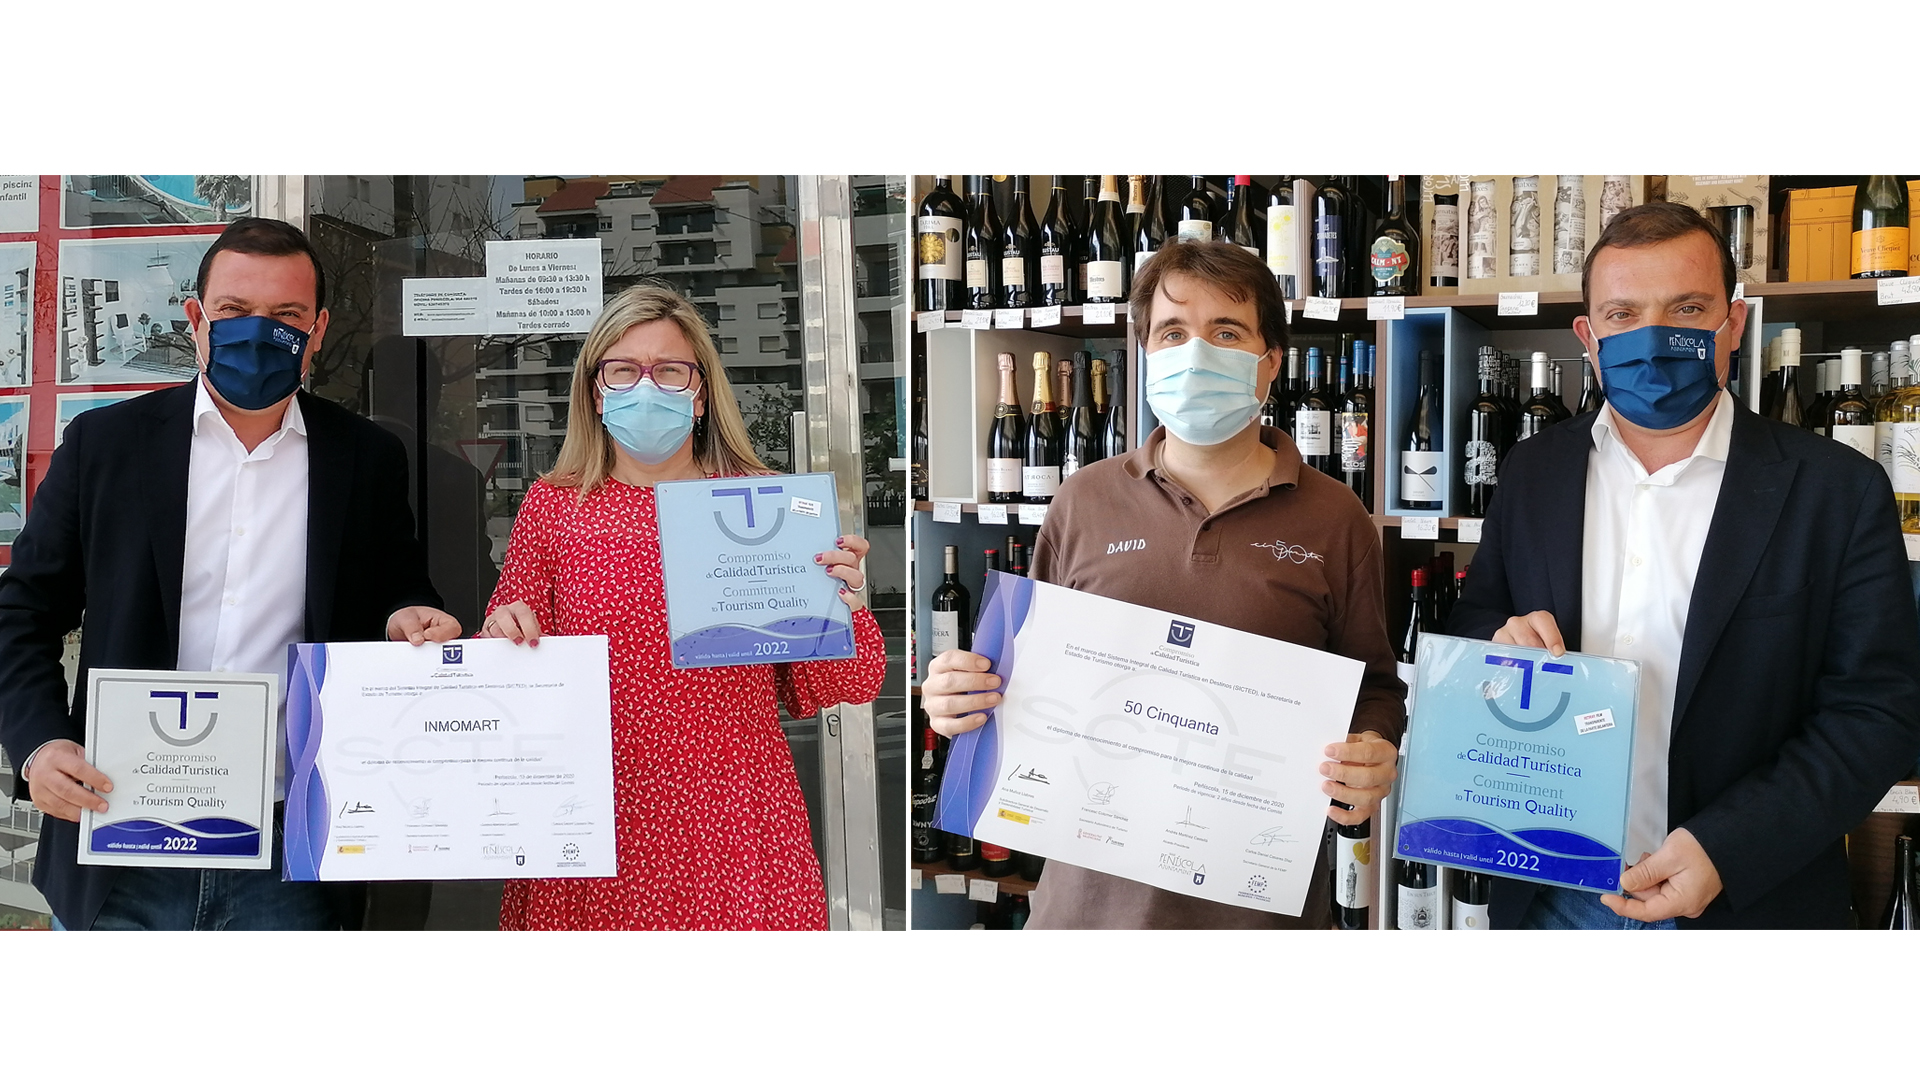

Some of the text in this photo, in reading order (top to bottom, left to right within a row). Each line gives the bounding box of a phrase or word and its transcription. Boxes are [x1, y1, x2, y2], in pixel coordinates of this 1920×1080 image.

[0, 193, 27, 201] nfantil
[520, 264, 540, 272] Lunes
[496, 276, 526, 284] Mañanas
[524, 287, 534, 295] de
[562, 286, 581, 294] 19:30
[496, 310, 527, 318] Mañanas
[529, 310, 537, 318] de
[543, 321, 570, 329] cerrado
[1106, 538, 1147, 555] DAVID
[717, 550, 791, 565] Compromiso
[705, 564, 807, 579] de Calidad Turística
[722, 585, 796, 598] Commitment
[717, 599, 765, 612] Tourism
[767, 597, 810, 611] Quality
[753, 641, 790, 657] 2022
[1064, 650, 1083, 659] Estado
[1092, 656, 1114, 666] Turismo
[1114, 662, 1131, 671] otorga
[1081, 647, 1097, 656] marco
[1107, 653, 1129, 663] Sistema
[1130, 659, 1149, 669] Integral
[1158, 665, 1178, 676] Calidad
[1210, 679, 1232, 690] Destinos
[1124, 700, 1219, 736] 50 Cinquanta
[424, 719, 500, 733] INMOMART
[1476, 733, 1566, 758] Compromiso
[146, 752, 217, 764] Compromiso
[1053, 726, 1073, 736] diploma
[1082, 734, 1122, 748] reconocimiento
[1128, 745, 1160, 757] compromiso
[1179, 758, 1197, 767] mejora
[1197, 762, 1220, 773] continua
[1234, 772, 1253, 781] calidad
[140, 764, 181, 776] Calidad
[1457, 749, 1582, 778] de Calidad Turística
[146, 783, 216, 794] Commitment
[1473, 774, 1564, 800] Commitment
[140, 796, 184, 807] Tourism
[187, 796, 227, 809] Quality
[1237, 792, 1262, 803] diciembre
[1271, 800, 1285, 809] 2020
[1455, 790, 1578, 821] to Tourism Quality
[164, 838, 197, 851] 2022
[1424, 846, 1540, 872] válido hasta valid until 2022
